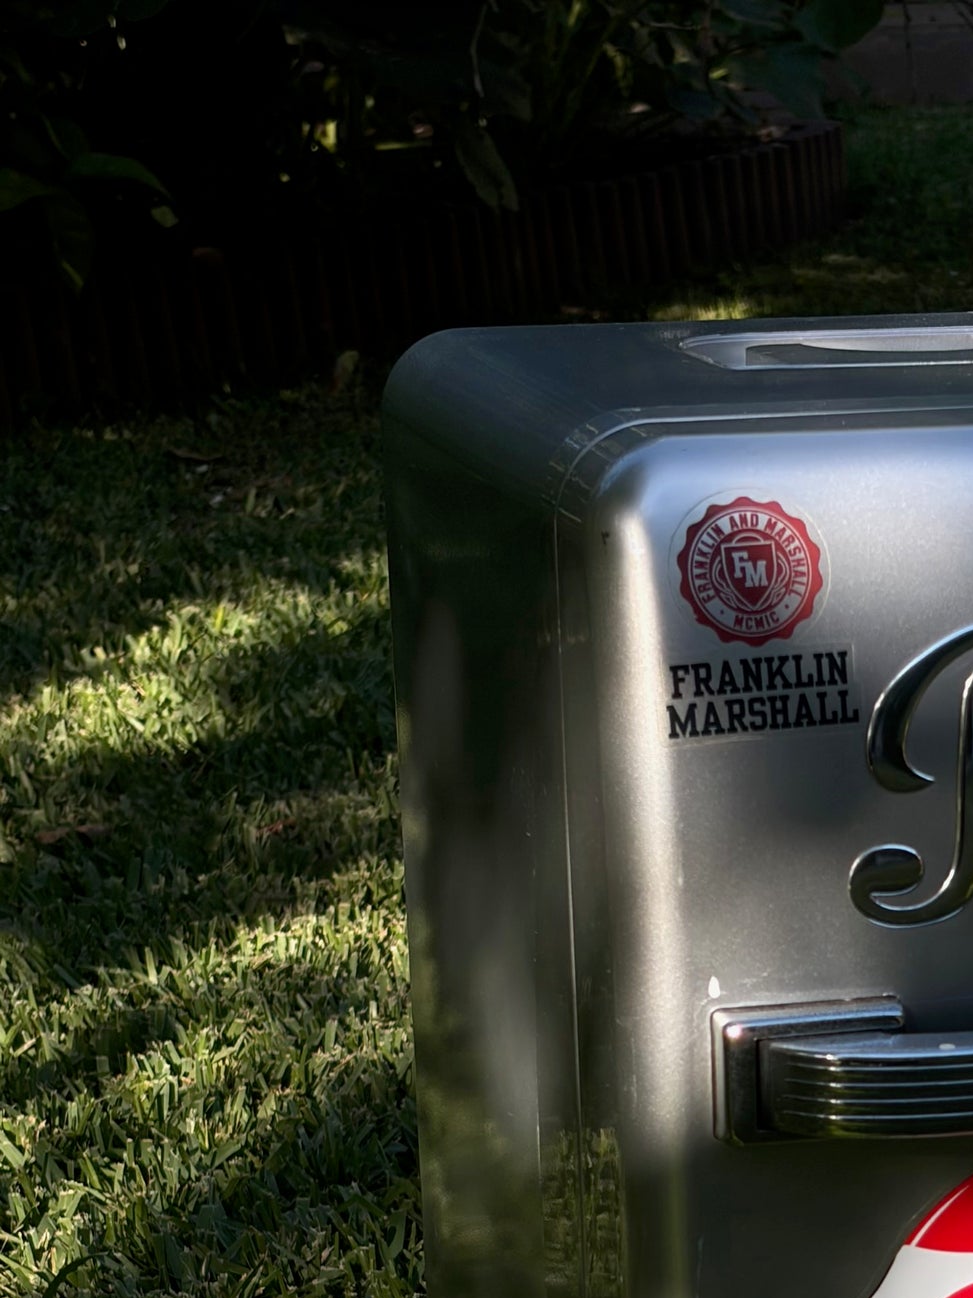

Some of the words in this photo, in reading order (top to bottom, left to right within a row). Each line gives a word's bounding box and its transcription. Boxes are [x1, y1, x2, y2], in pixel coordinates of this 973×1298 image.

[694, 523, 725, 604] FRANKLIN
[728, 513, 759, 531] AND
[765, 517, 808, 599] MARSHALL
[731, 551, 768, 588] FM
[733, 611, 780, 630] MCMIC
[669, 650, 849, 699] FRANKLIN
[666, 689, 860, 739] MARSHALL
